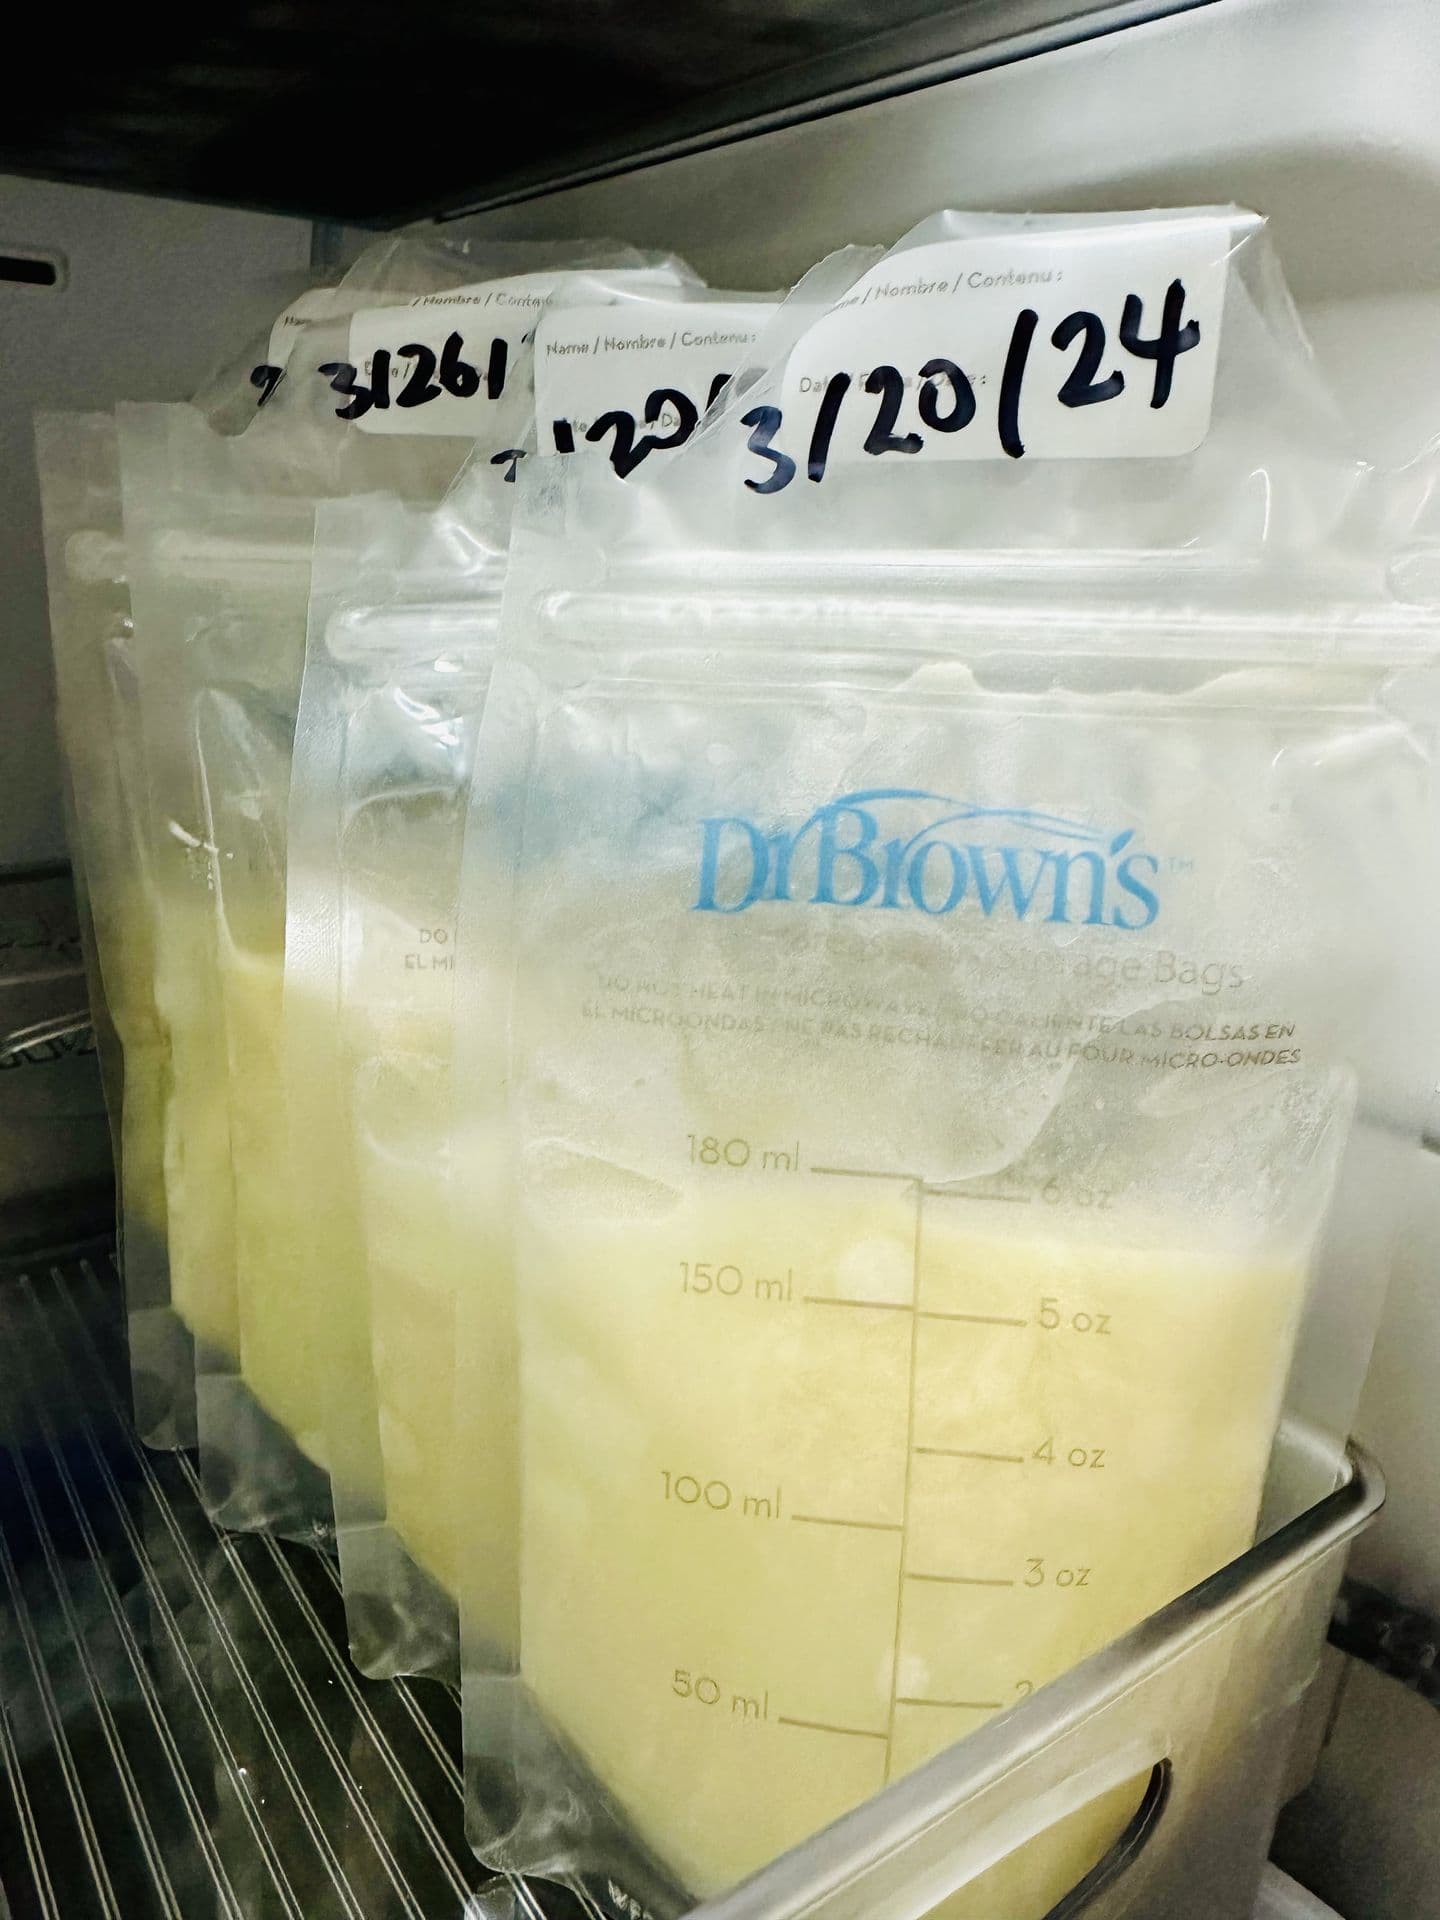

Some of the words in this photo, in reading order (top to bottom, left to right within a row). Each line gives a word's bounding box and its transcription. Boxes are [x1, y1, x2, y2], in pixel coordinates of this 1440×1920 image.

[875, 279, 949, 299] Nombre
[967, 271, 1063, 289] Contenu:
[604, 333, 667, 351] Nombre
[681, 331, 758, 347] Contenu:
[740, 278, 1200, 494] 3/20/24
[1154, 950, 1244, 996] Bags
[1169, 1022, 1260, 1042] BOLSAS
[1263, 1021, 1297, 1040] EN
[1067, 1042, 1135, 1065] FOUR
[1140, 1047, 1303, 1071] MICRO-ONDES
[687, 1133, 751, 1168] 180
[761, 1140, 800, 1172] ml
[679, 1261, 744, 1296] 150
[754, 1268, 793, 1302] ml
[1038, 1297, 1061, 1331] 5
[1072, 1312, 1112, 1336] oz
[1031, 1436, 1056, 1466] 4
[1067, 1445, 1106, 1469] oz
[660, 1470, 733, 1511] 100
[742, 1487, 782, 1520] ml
[1023, 1557, 1045, 1588] 3
[1054, 1565, 1092, 1588] oz
[671, 1668, 721, 1705] 50
[731, 1690, 769, 1721] ml
